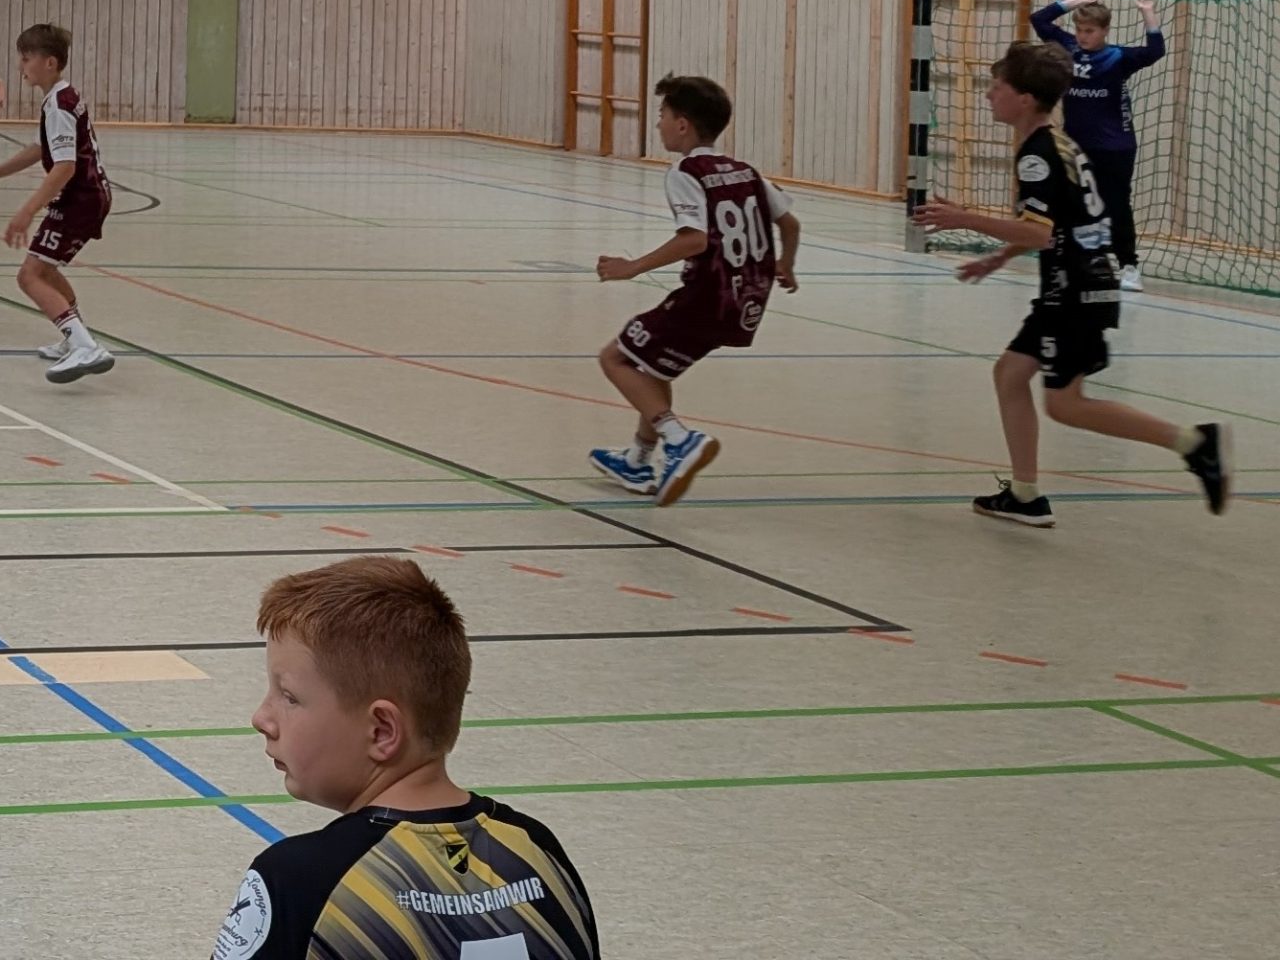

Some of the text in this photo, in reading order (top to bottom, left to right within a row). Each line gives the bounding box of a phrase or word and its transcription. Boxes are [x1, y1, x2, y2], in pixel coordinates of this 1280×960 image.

[39, 228, 63, 251] 15
[715, 195, 769, 268] 80
[626, 320, 651, 348] 80
[1040, 336, 1057, 359] 5
[395, 876, 546, 916] #GEMEINSAMWIR
